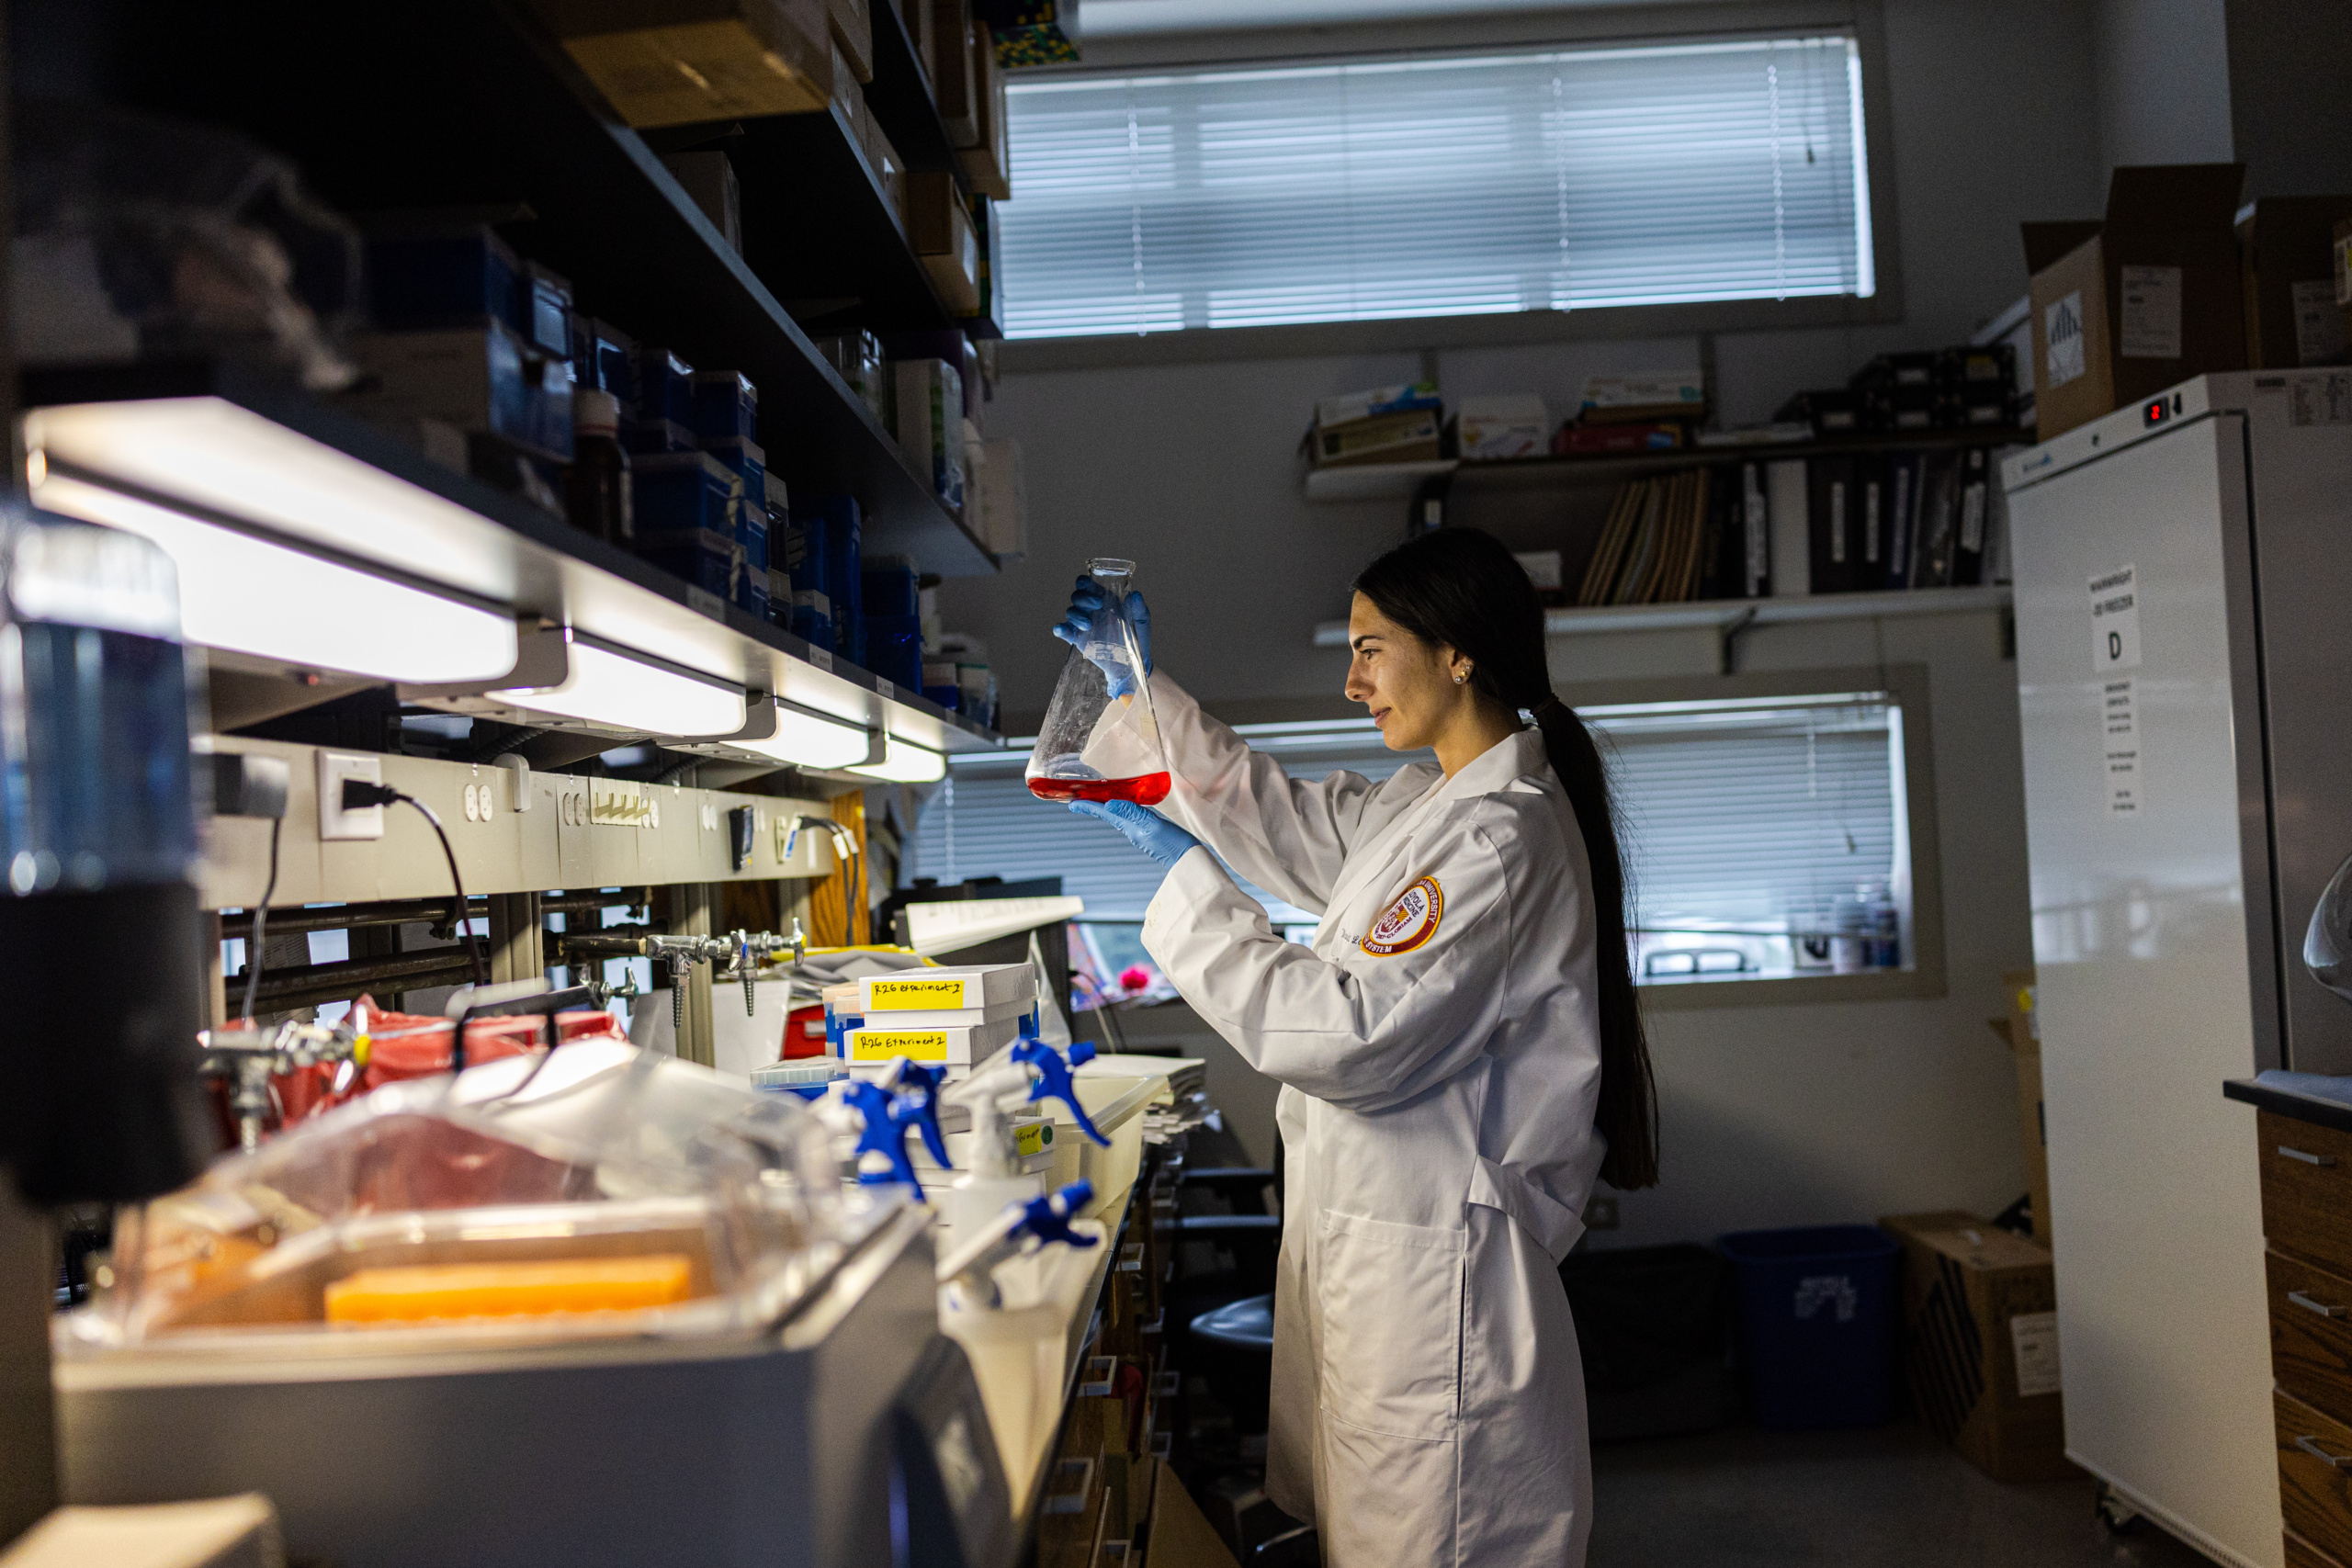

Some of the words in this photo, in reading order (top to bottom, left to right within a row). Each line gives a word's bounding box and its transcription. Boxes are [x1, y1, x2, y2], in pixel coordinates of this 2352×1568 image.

[2108, 631, 2121, 660] D
[1403, 896, 1419, 917] MEDICINE
[1408, 889, 1425, 912] LOYOLA
[1424, 880, 1439, 923] UNIVERSITY
[1365, 941, 1393, 953] SYSTEM
[875, 984, 897, 996] R26
[860, 1036, 882, 1049] R26
[936, 1036, 945, 1045] 2
